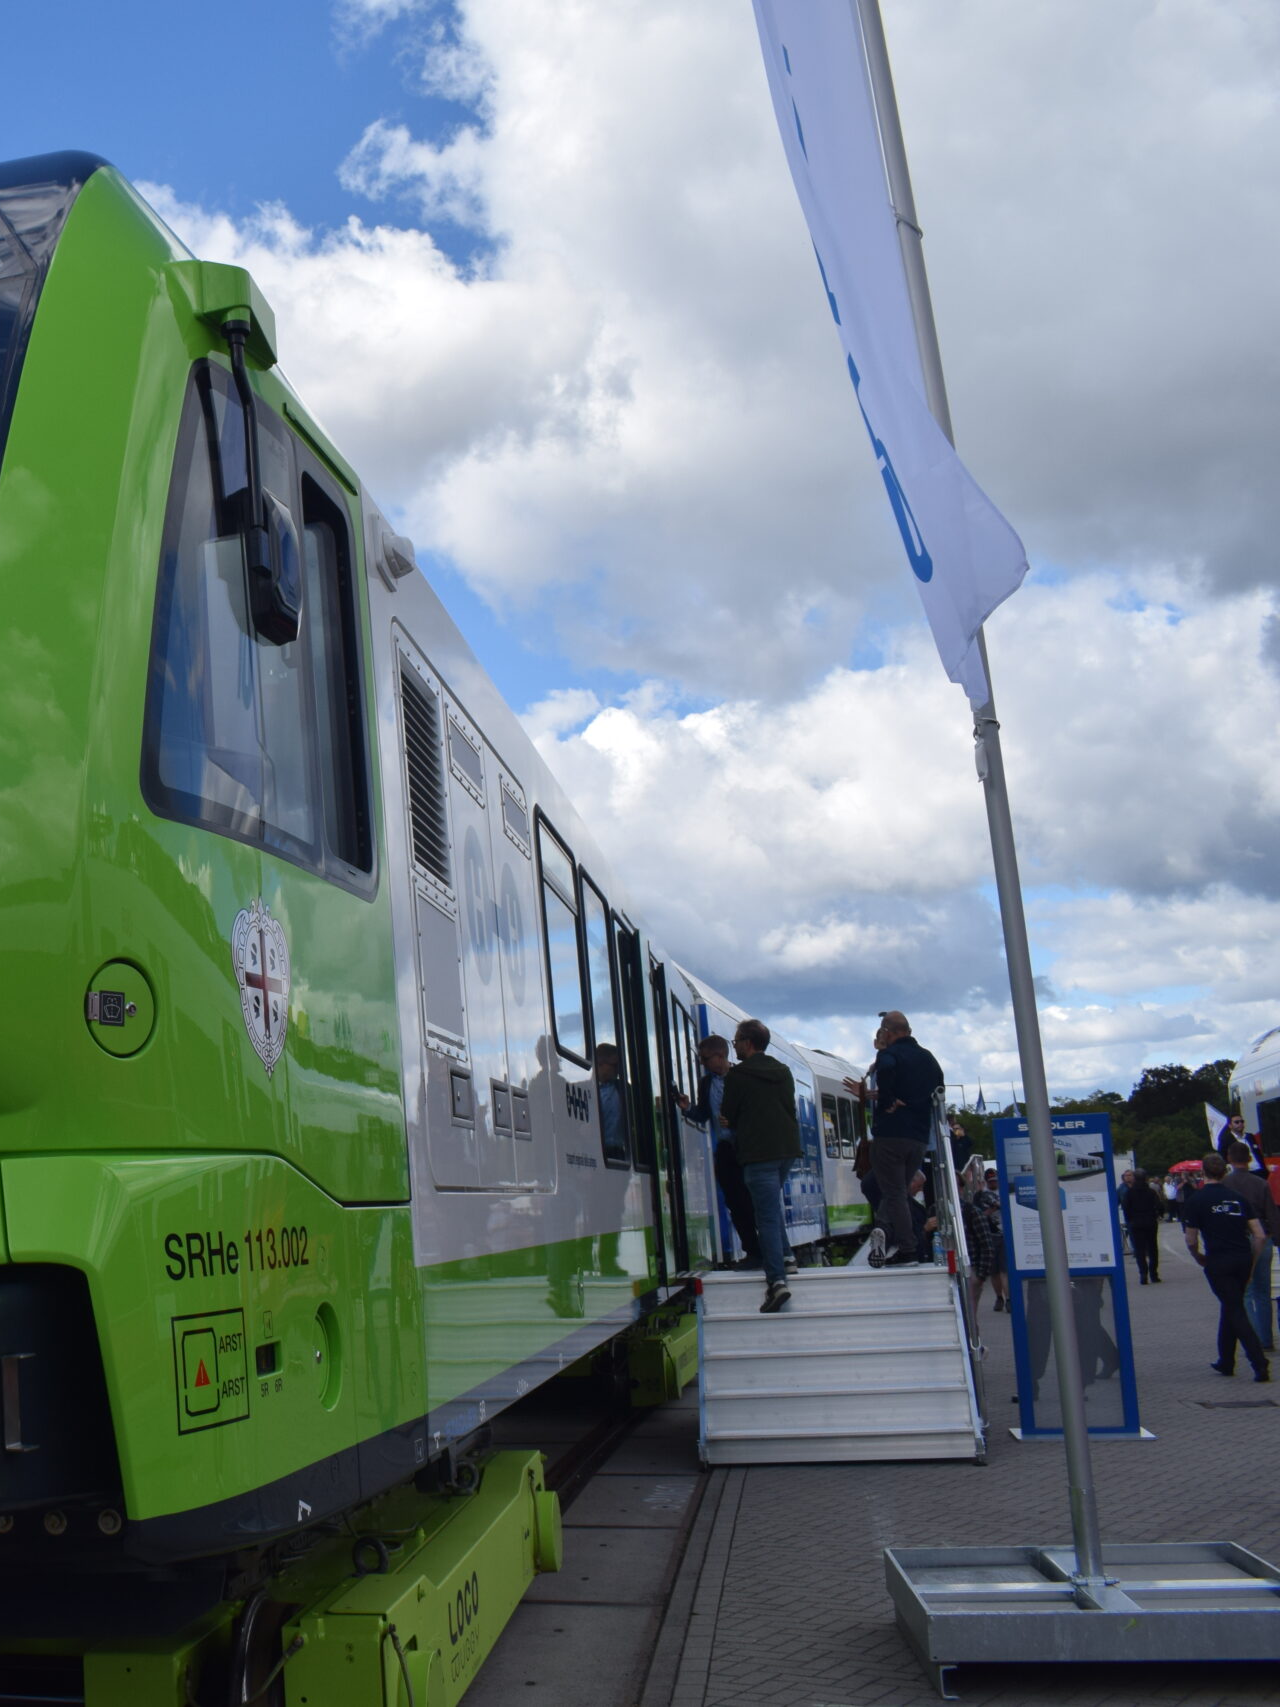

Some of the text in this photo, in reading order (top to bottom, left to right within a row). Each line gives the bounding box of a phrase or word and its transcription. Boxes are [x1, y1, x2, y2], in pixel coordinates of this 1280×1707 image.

[164, 1226, 309, 1280] SRHe 113.002
[219, 1333, 242, 1354] ARST
[222, 1377, 246, 1399] ARST
[447, 1570, 479, 1645] LOCO
